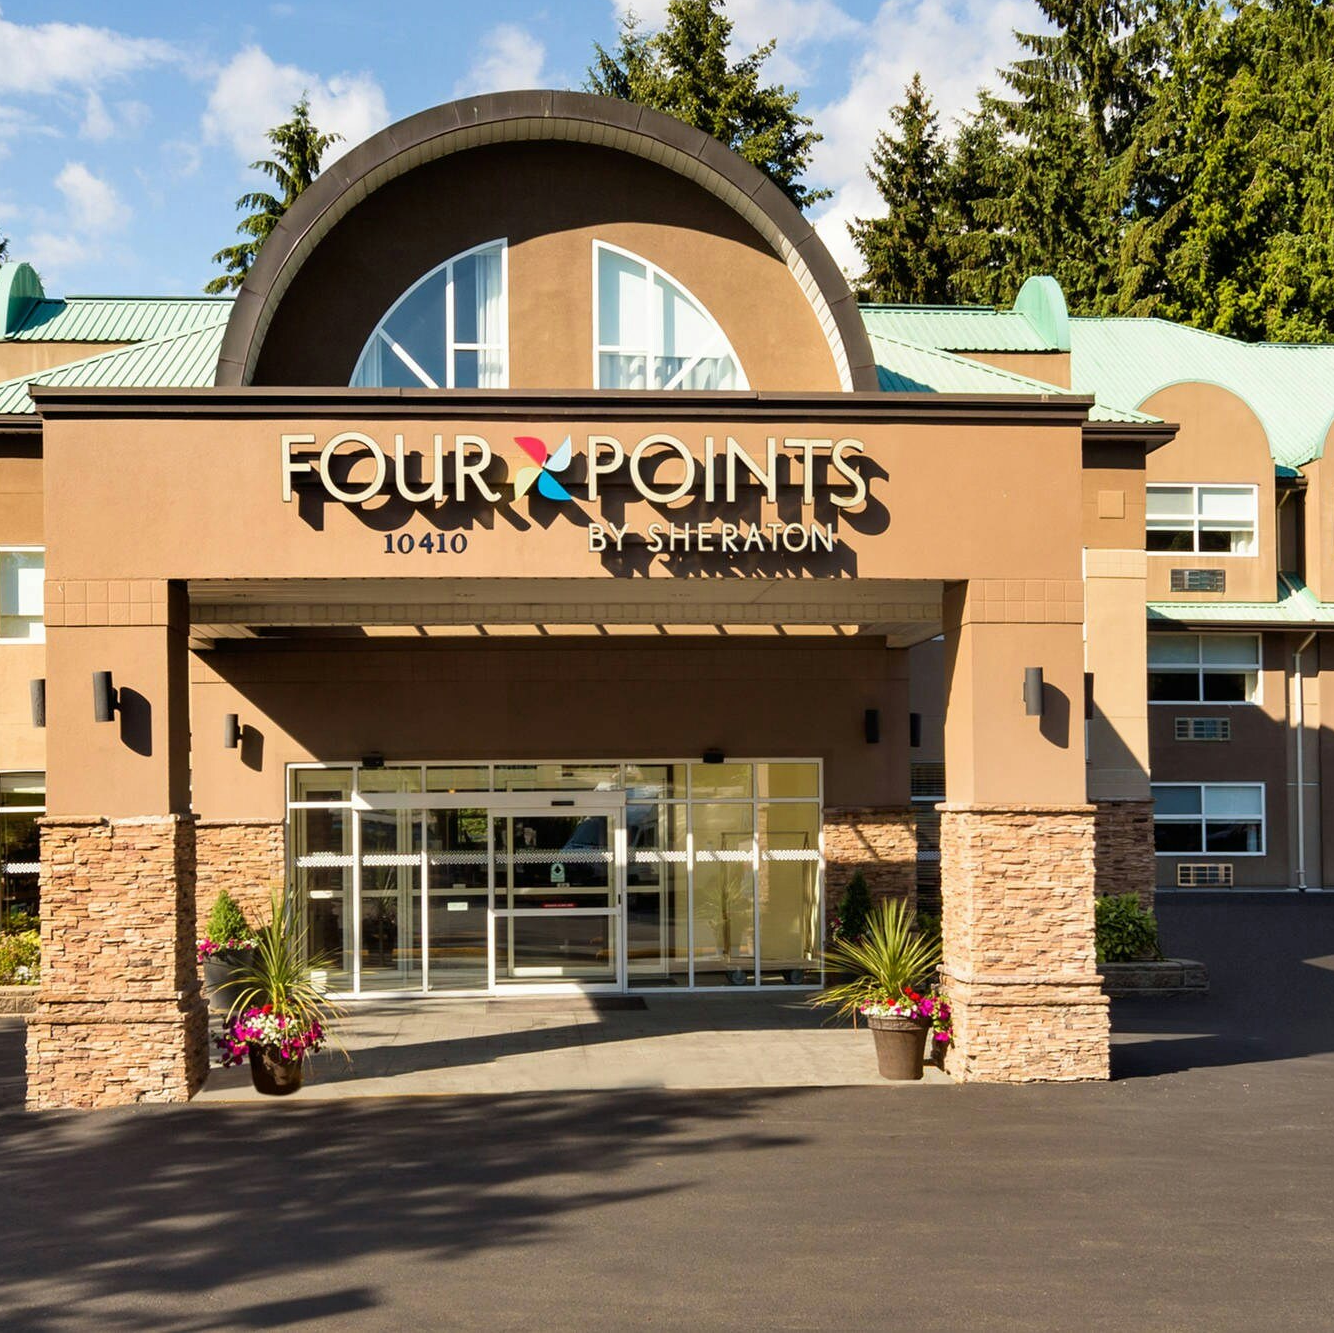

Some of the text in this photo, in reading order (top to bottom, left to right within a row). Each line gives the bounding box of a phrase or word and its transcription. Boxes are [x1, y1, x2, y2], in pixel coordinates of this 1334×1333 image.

[280, 431, 866, 508] FOUR POINTS
[383, 532, 468, 554] 10410
[588, 522, 833, 553] BY SHERATON
